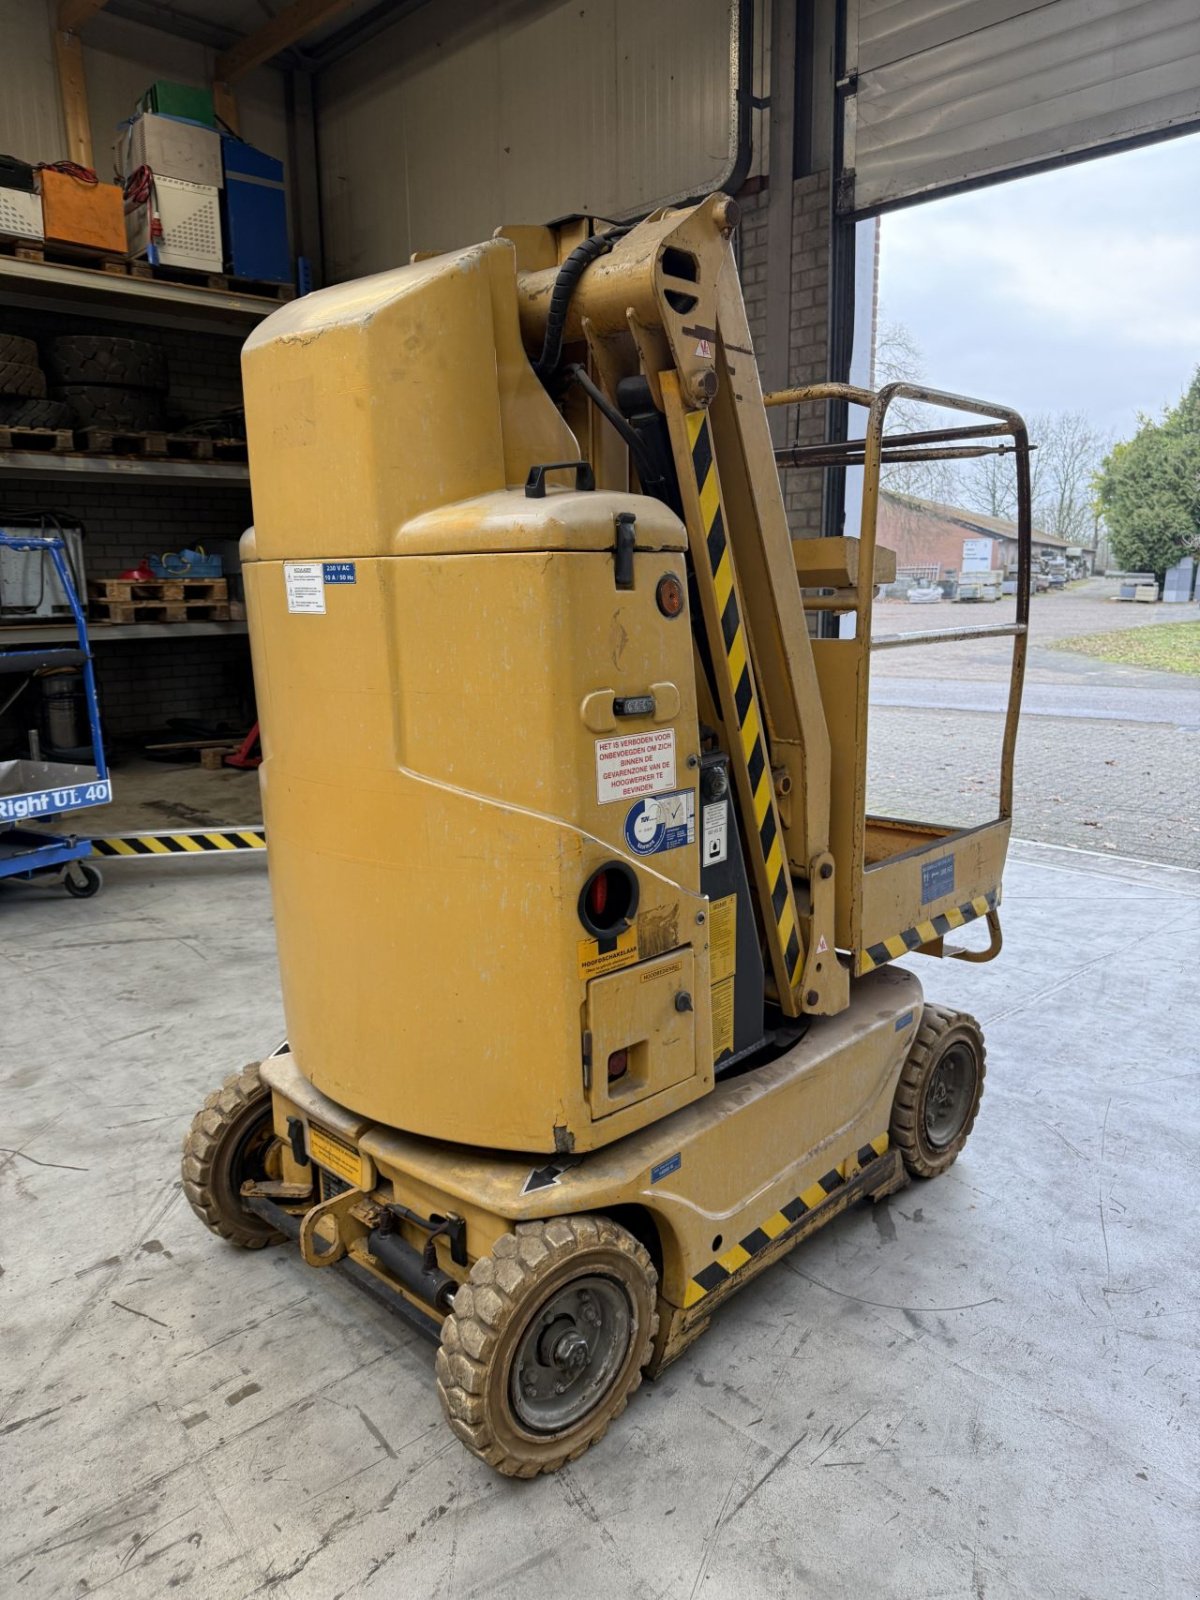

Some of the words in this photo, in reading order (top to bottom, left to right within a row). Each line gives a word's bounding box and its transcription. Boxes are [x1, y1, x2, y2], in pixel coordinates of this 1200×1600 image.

[599, 742, 612, 751] HET
[612, 741, 620, 749] IS
[620, 735, 653, 747] VERBODEN
[654, 733, 671, 742] VOOR
[599, 747, 646, 761] ONBEVOEGDEN
[646, 745, 657, 753] OM
[657, 742, 672, 751] ZICH
[620, 756, 644, 767] BINNEN
[644, 754, 653, 763] DE
[602, 765, 648, 780] GEVARENZONE
[649, 763, 661, 771] VAN
[662, 761, 670, 769] DE
[611, 773, 655, 788] HOOGWERKER
[656, 771, 664, 779] TE
[52, 789, 82, 807] UL
[85, 784, 107, 801] 40
[622, 783, 653, 796] BEVINDEN
[581, 946, 637, 969] HOOFDSCHAKELAAR
